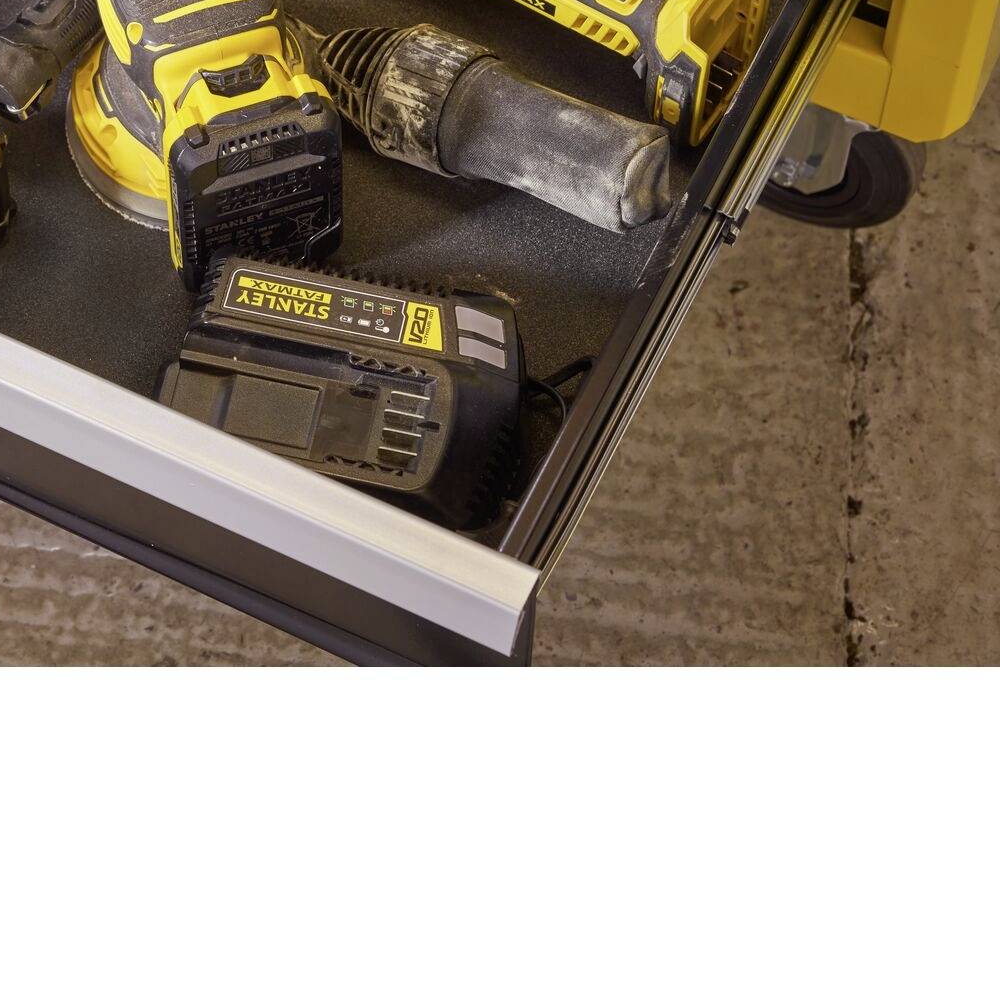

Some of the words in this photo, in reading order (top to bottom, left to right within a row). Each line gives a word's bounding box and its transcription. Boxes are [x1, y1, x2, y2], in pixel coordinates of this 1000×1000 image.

[236, 289, 331, 321] STANLEY
[251, 279, 325, 303] FATMAX
[408, 306, 430, 344] V20
